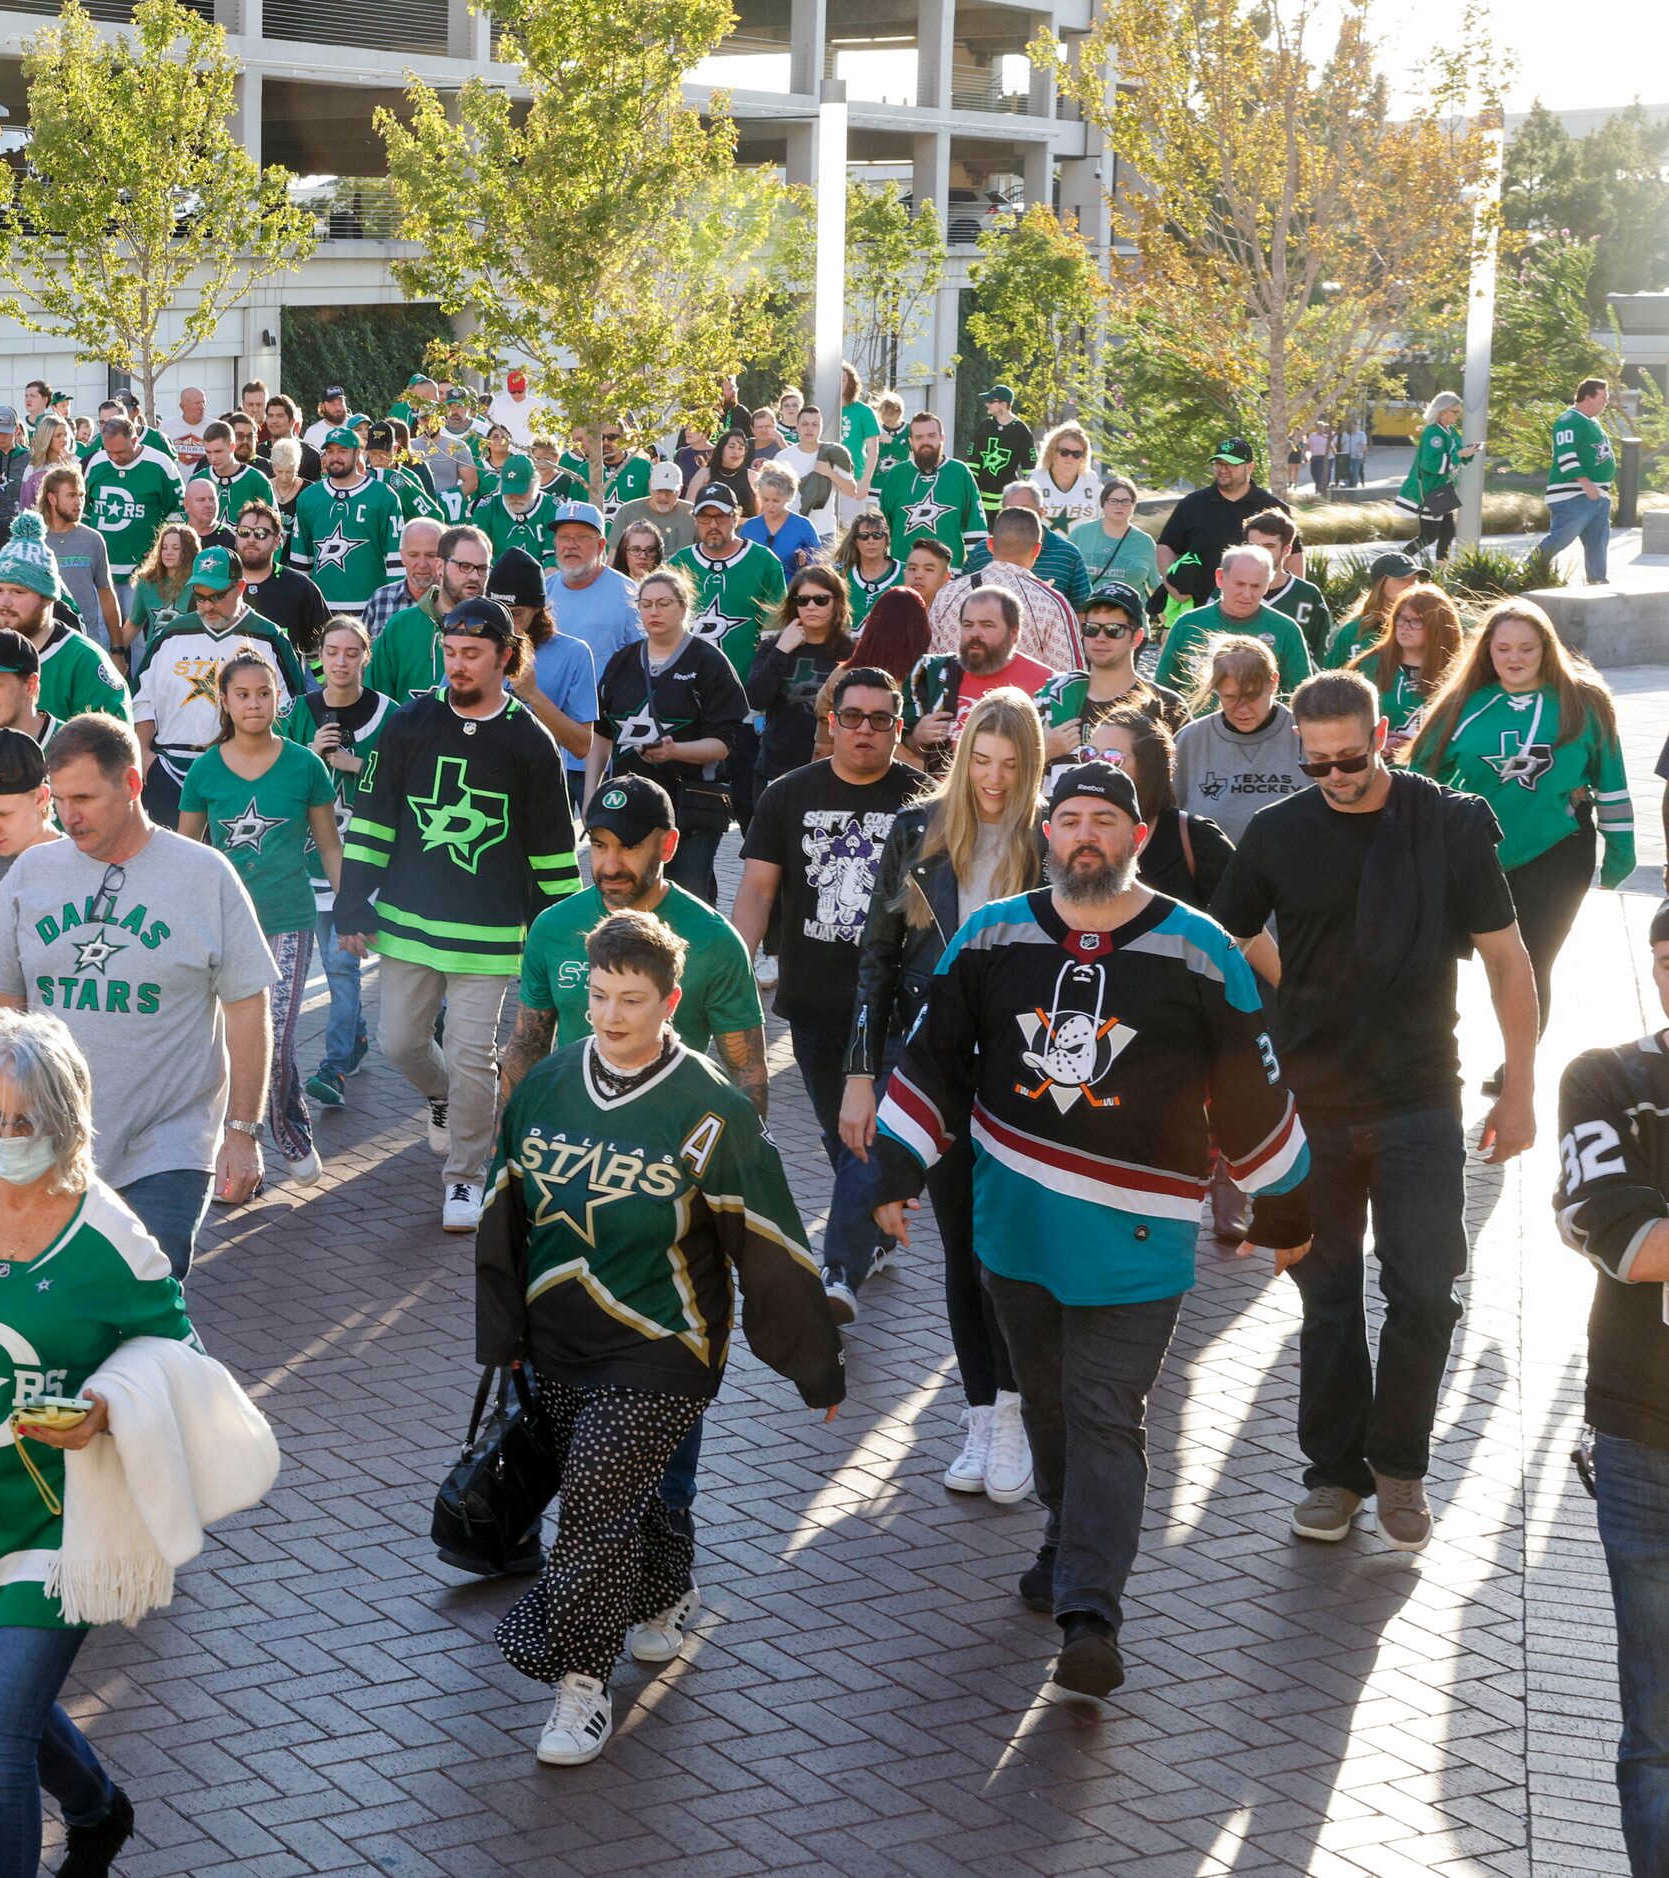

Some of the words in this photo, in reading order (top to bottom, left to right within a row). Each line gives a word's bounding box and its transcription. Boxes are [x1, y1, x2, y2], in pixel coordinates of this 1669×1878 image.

[94, 499, 146, 519] STRS
[356, 504, 367, 523] C
[389, 515, 405, 539] 14
[1297, 603, 1313, 623] C
[1077, 783, 1106, 795] Reebok
[1233, 773, 1292, 784] TEXAS
[803, 810, 855, 828] SHIFT
[803, 919, 840, 944] MUAY
[36, 975, 161, 1014] STARS
[530, 1127, 674, 1164] DALLAS
[680, 1111, 727, 1179] A
[520, 1136, 682, 1197] STARS
[1559, 1119, 1627, 1196] 32
